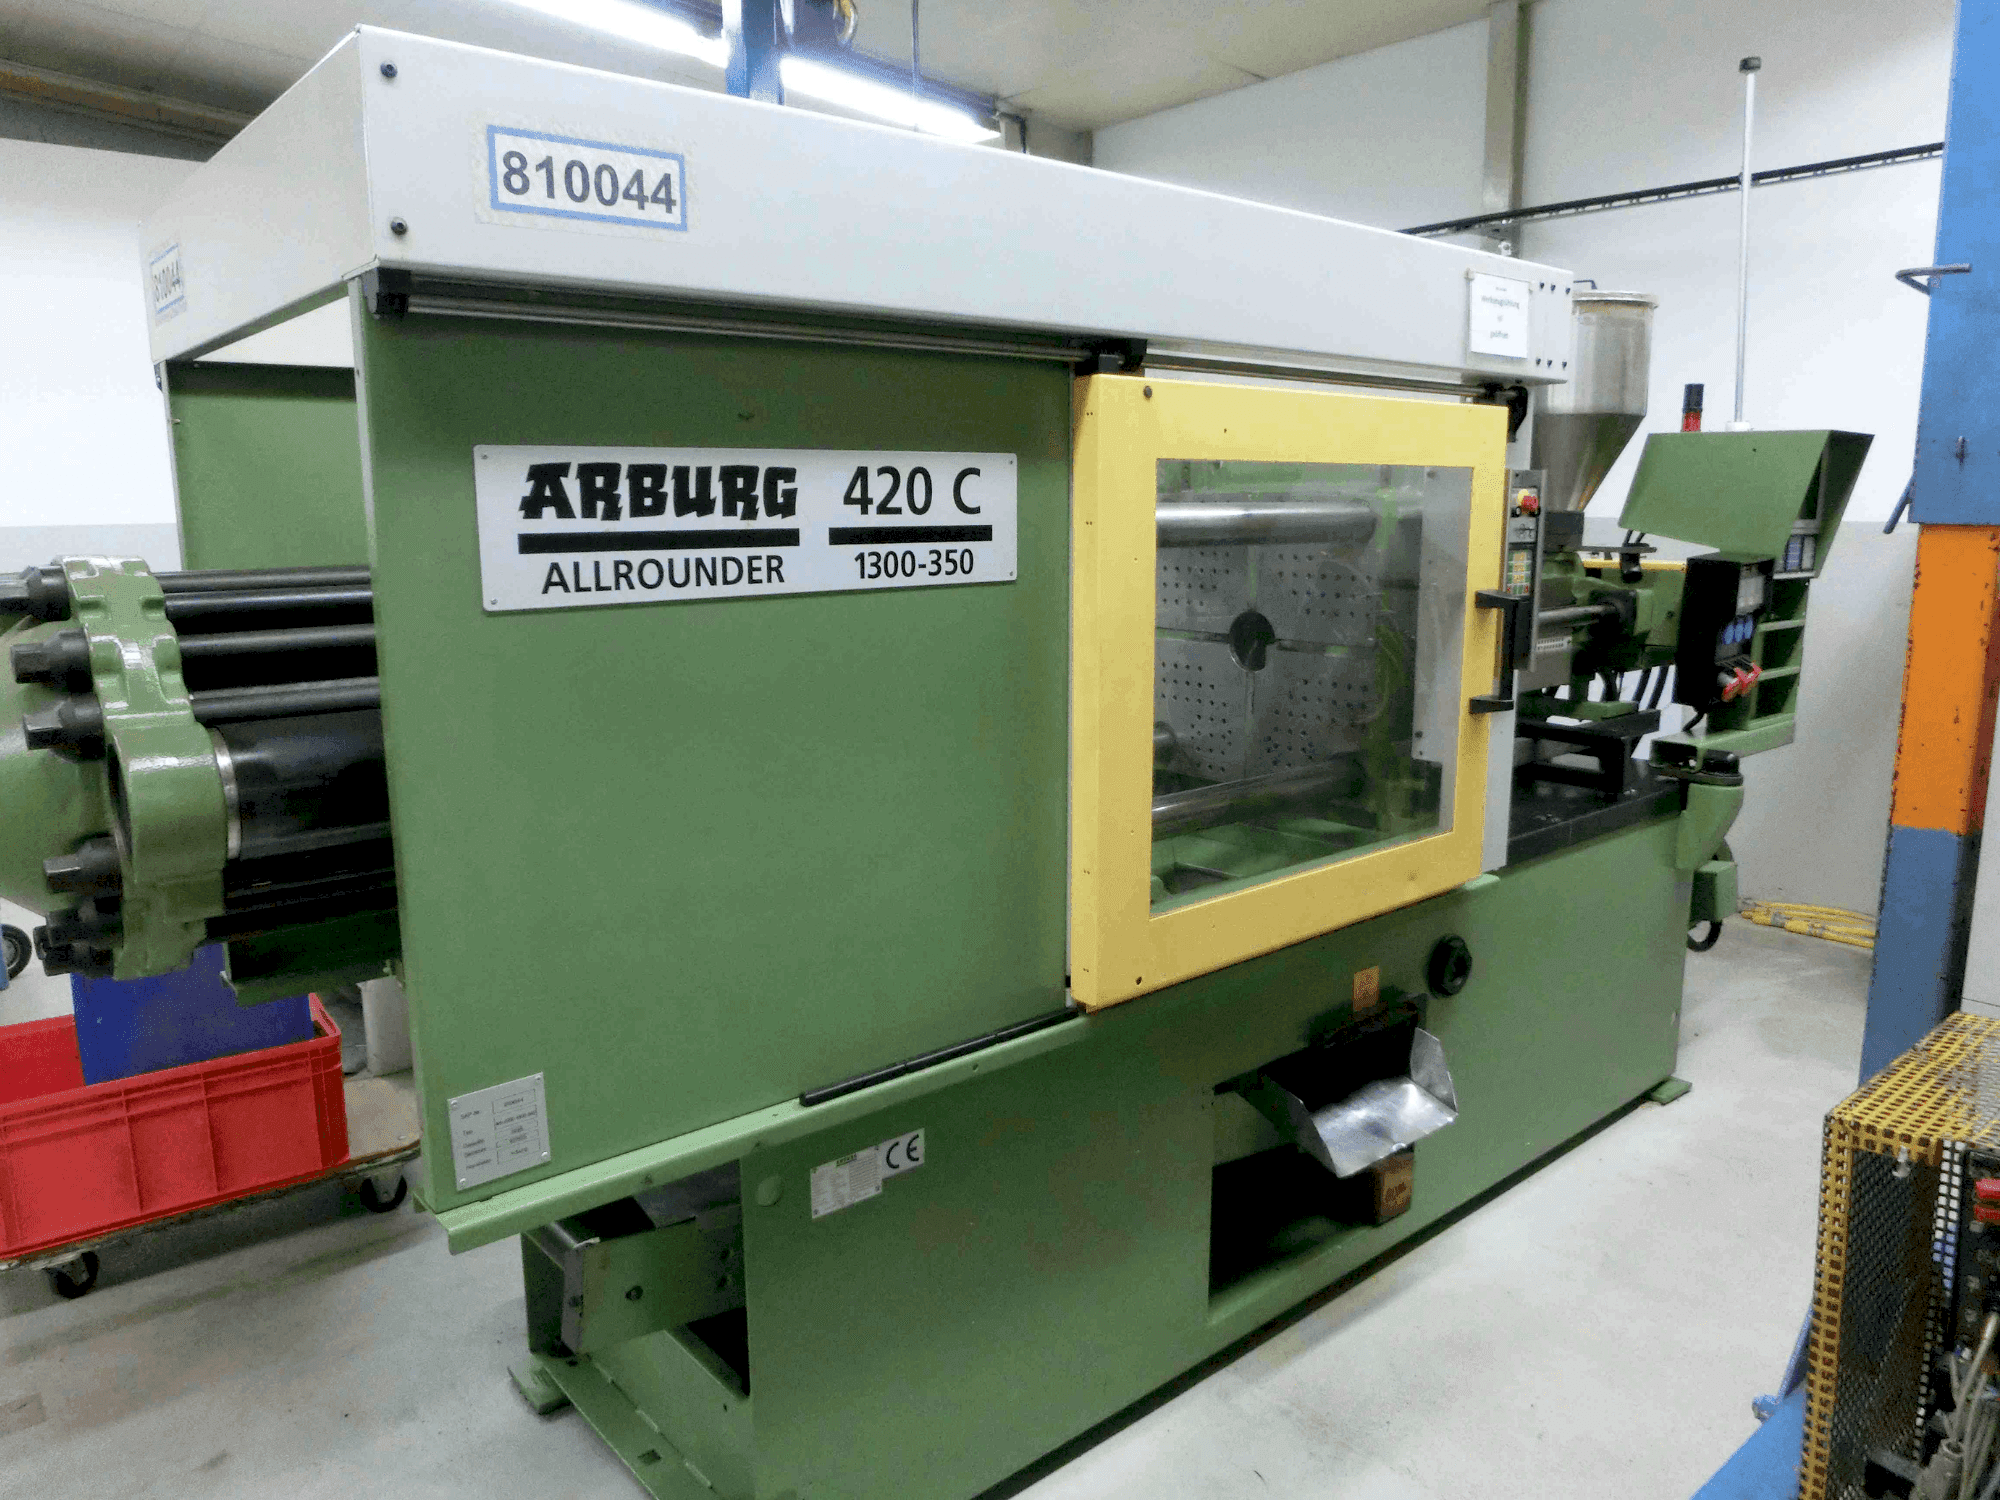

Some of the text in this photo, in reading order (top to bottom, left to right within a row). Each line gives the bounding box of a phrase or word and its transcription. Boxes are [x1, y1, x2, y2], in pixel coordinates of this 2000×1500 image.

[503, 150, 677, 214] 810044
[518, 461, 798, 521] ARBURG
[843, 465, 981, 516] 420 C
[541, 554, 785, 594] ALLROUNDER
[853, 548, 974, 579] 1300-350
